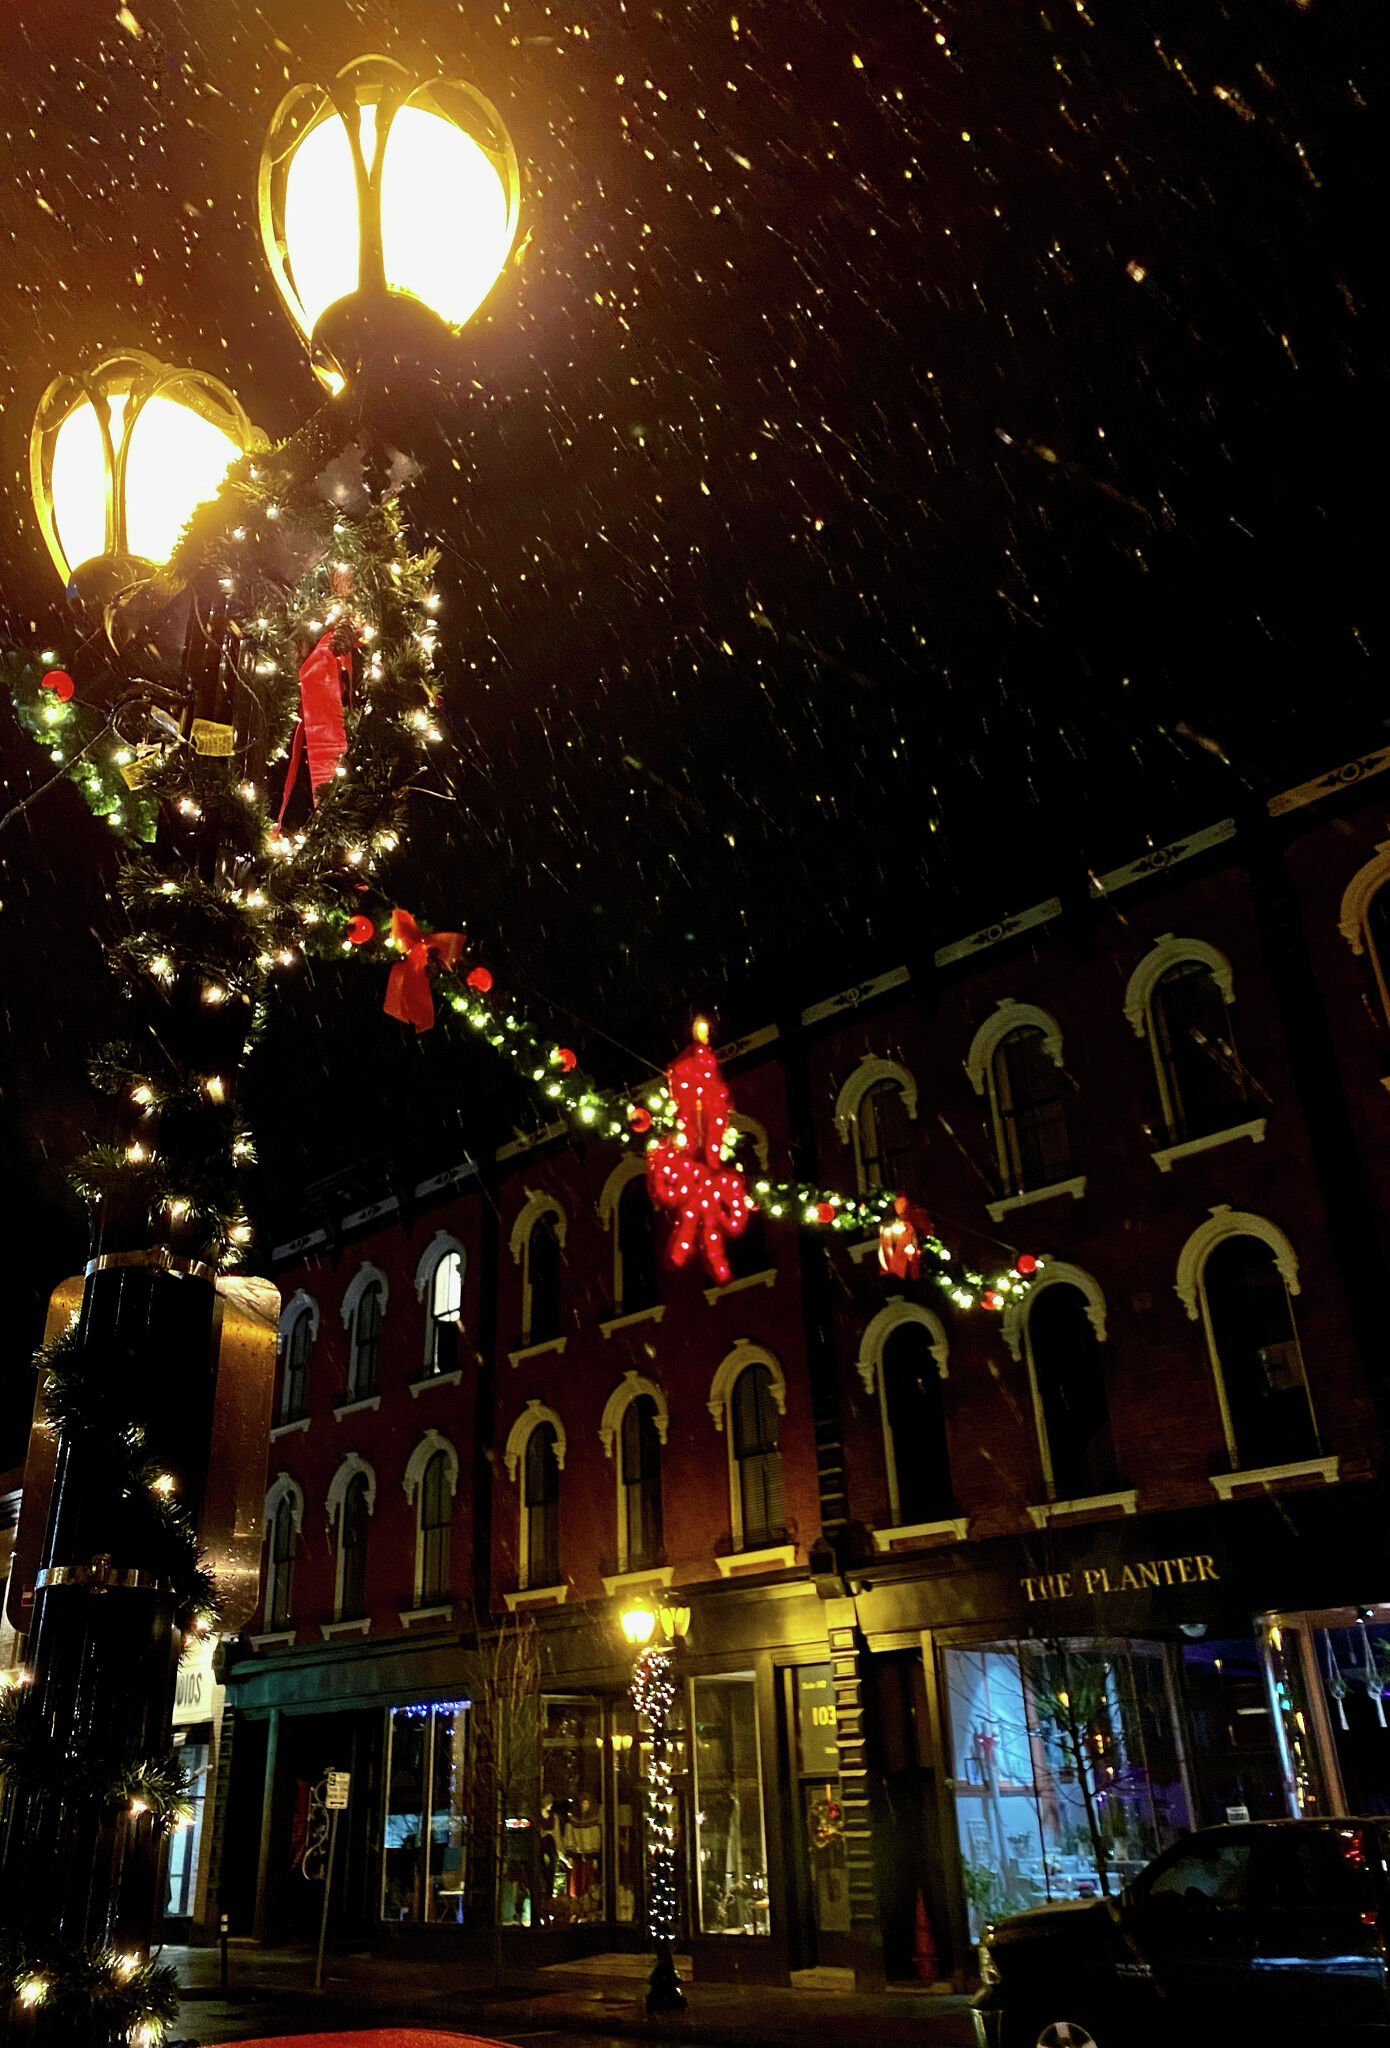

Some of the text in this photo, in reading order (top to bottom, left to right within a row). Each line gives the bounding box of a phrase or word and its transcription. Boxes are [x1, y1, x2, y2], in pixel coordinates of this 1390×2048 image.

[1020, 1555, 1220, 1602] THE PLANTER
[812, 1706, 837, 1726] 103
